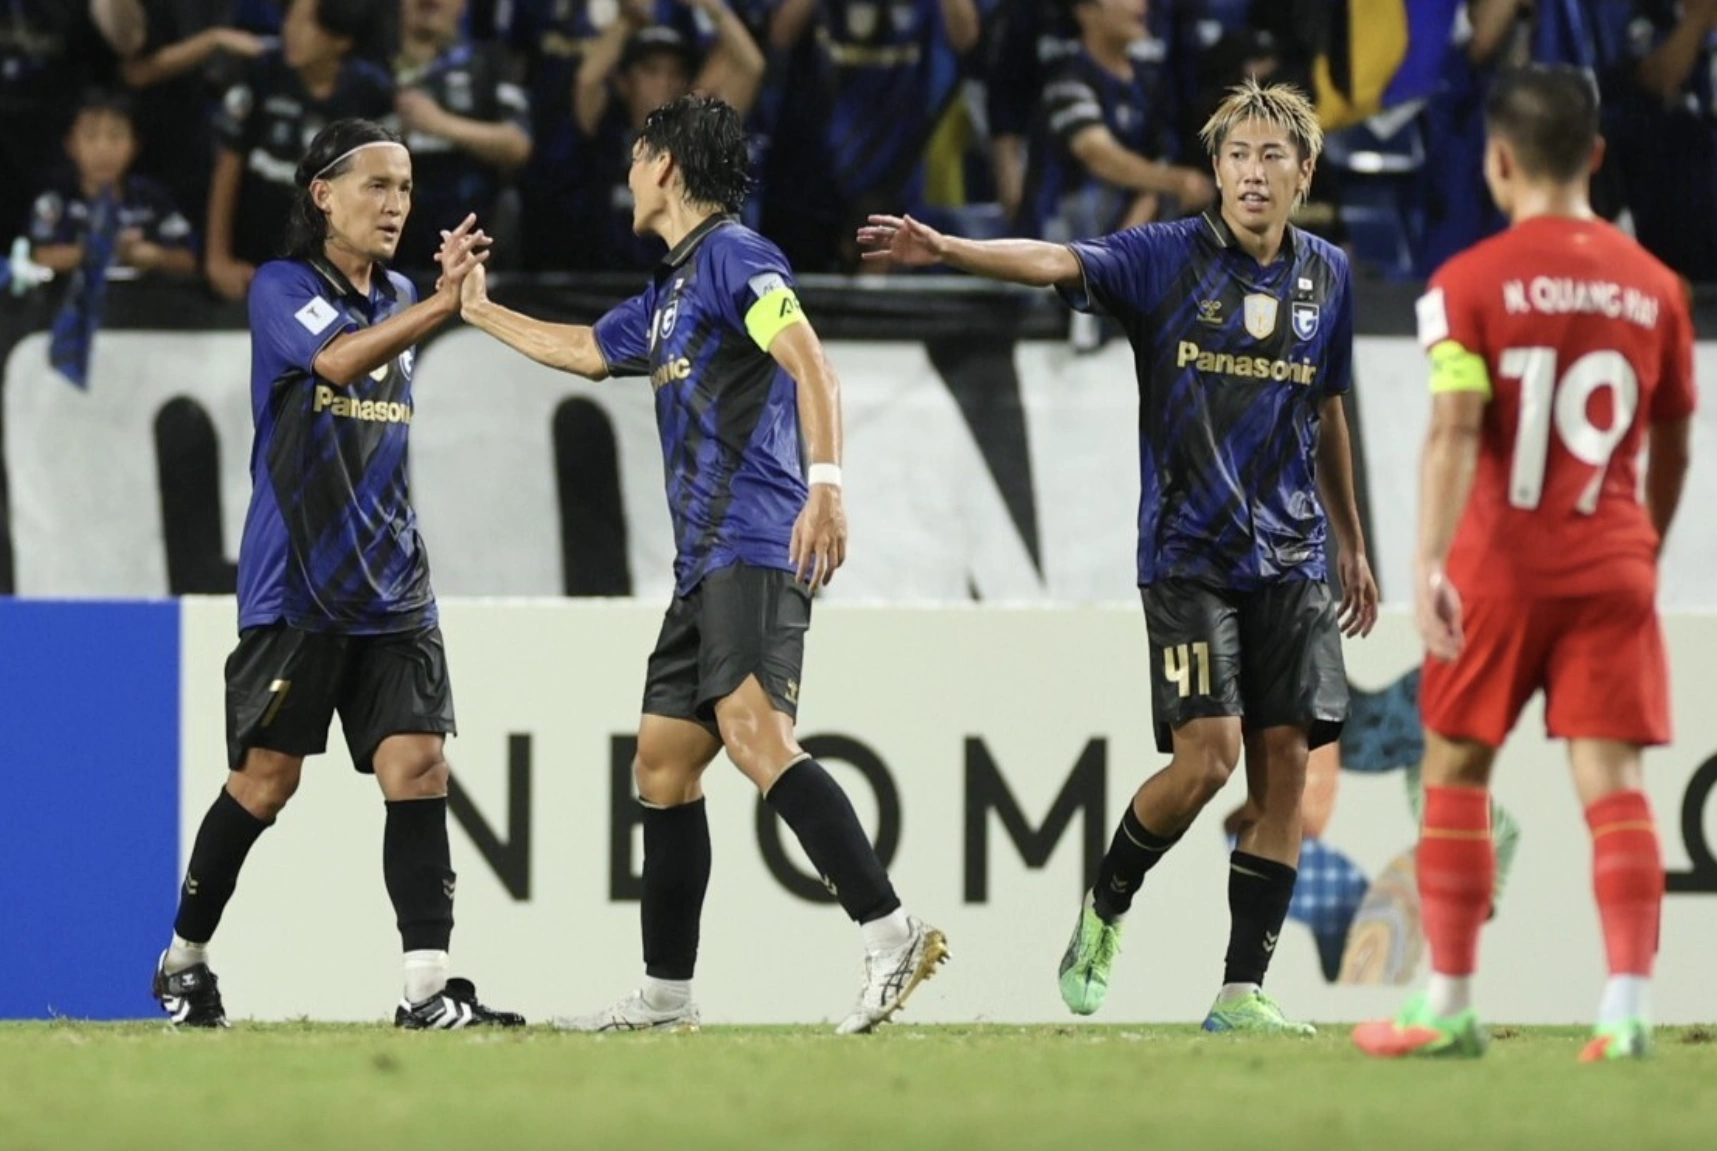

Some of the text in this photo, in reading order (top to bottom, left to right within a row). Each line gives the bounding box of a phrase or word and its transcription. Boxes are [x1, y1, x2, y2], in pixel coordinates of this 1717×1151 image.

[1530, 275, 1621, 319] QUANG
[313, 385, 411, 424] Panason
[1499, 346, 1639, 516] 19
[1164, 641, 1210, 698] 41
[261, 679, 291, 727] 7
